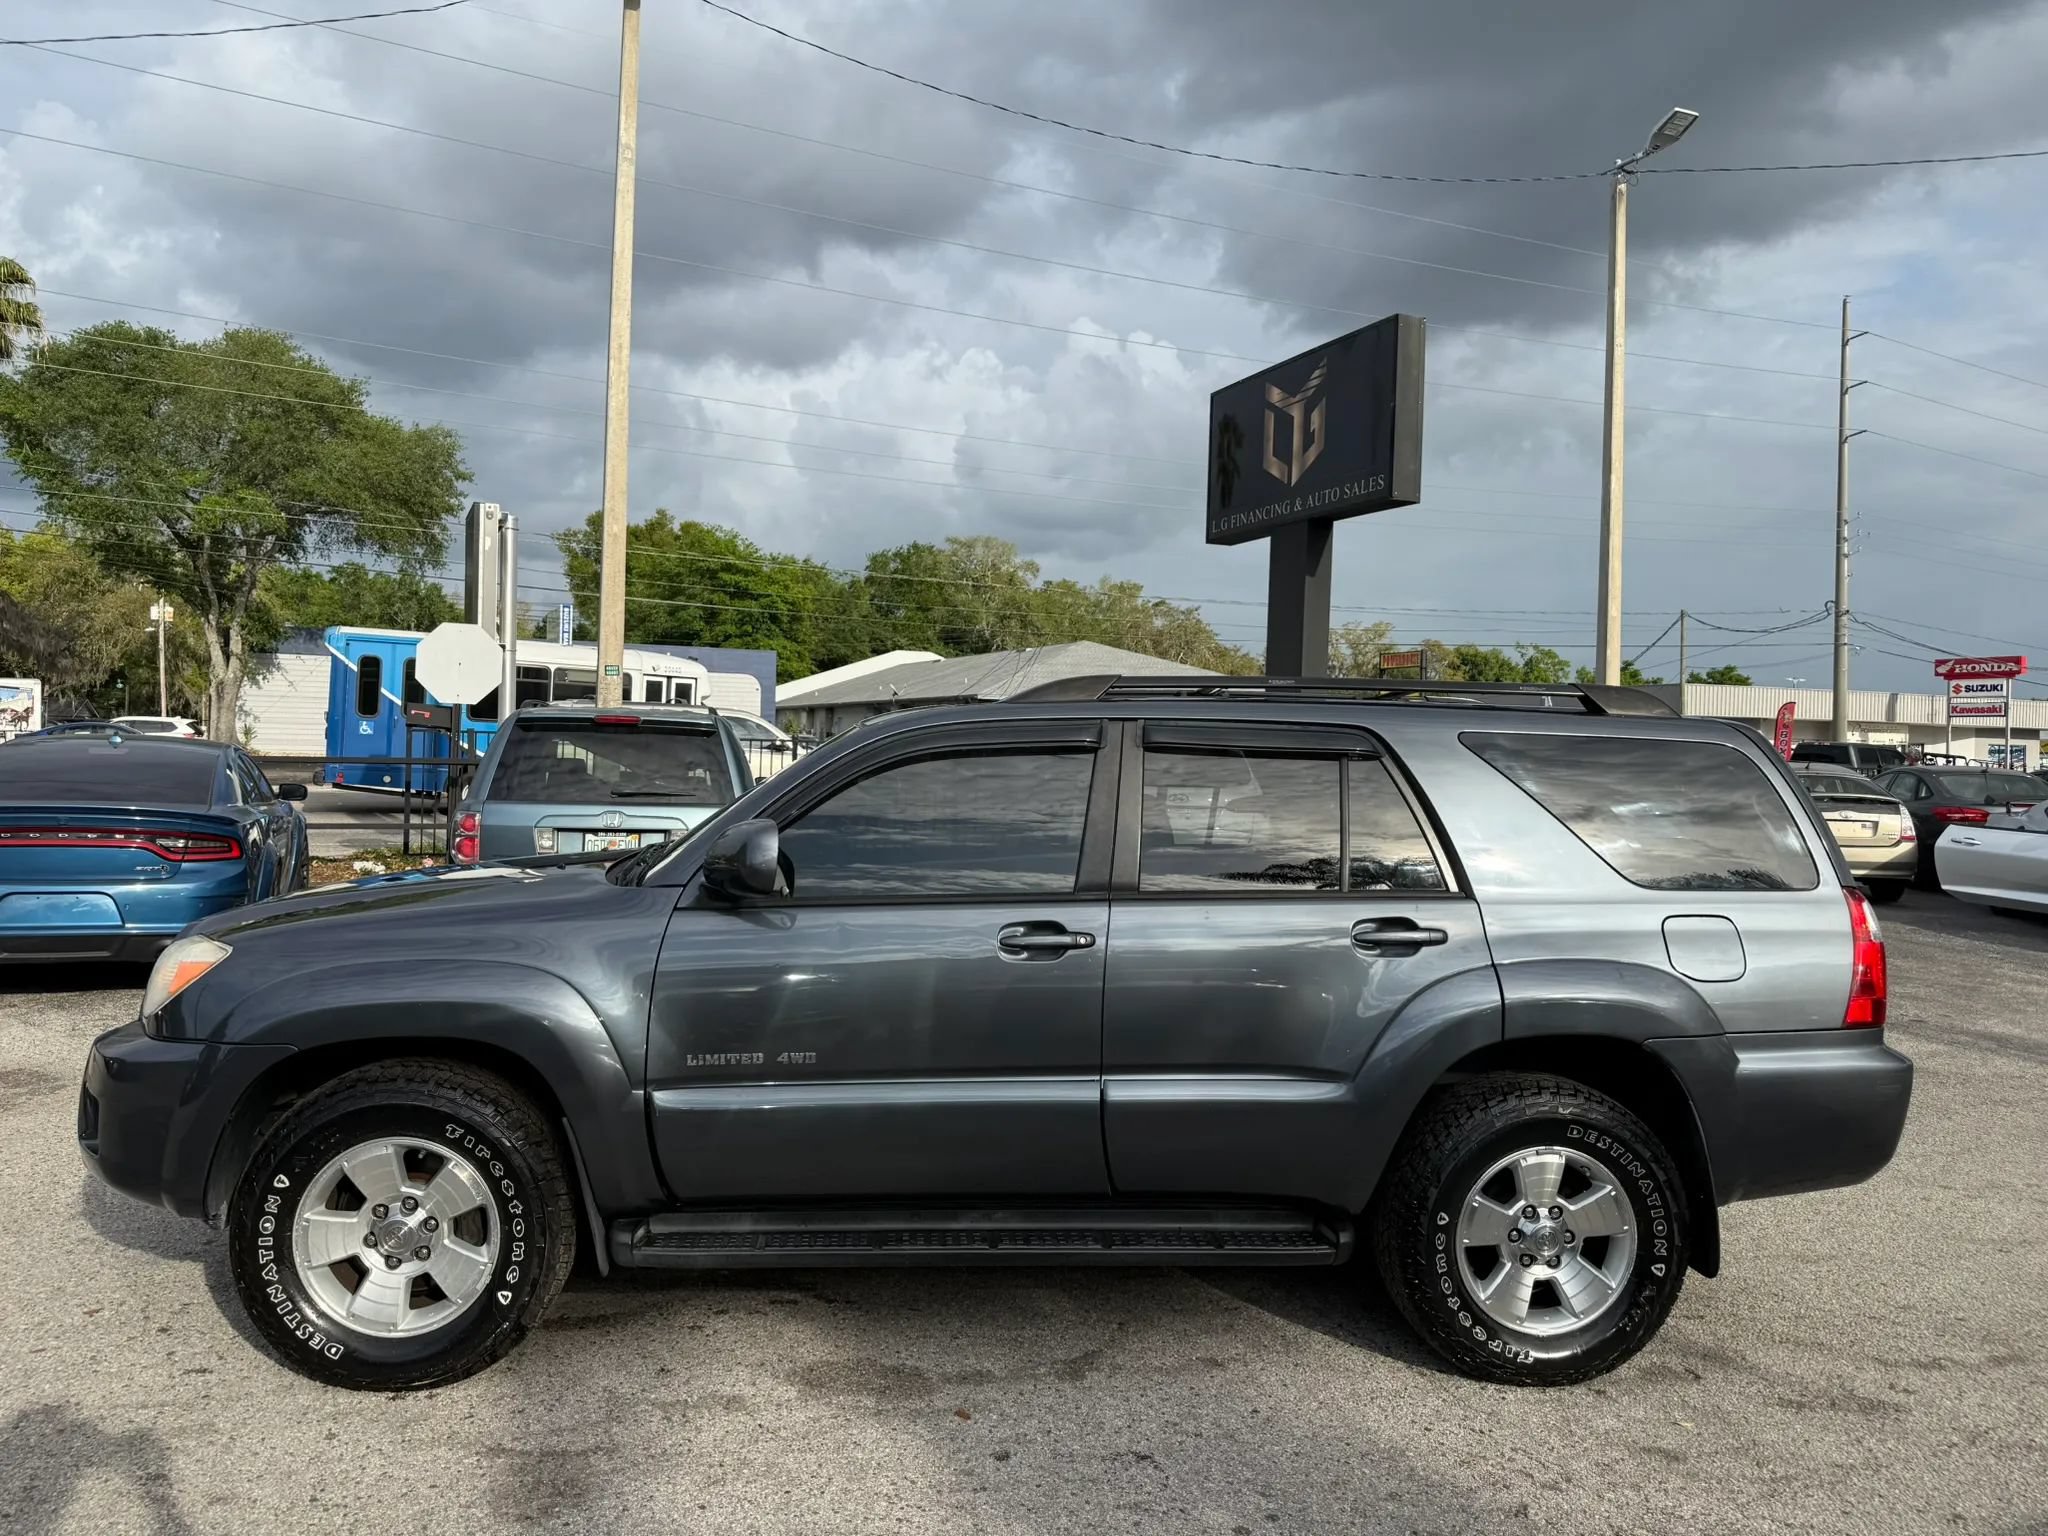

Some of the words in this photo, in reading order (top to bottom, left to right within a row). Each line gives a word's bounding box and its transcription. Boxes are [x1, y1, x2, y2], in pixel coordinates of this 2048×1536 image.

[1230, 500, 1291, 529] FINANCING
[1293, 497, 1303, 512] &
[1305, 487, 1340, 509] AUTO
[1343, 474, 1385, 499] SALES
[1954, 662, 2020, 673] HONDA
[1964, 683, 2004, 693] SUZUKI
[1951, 704, 2003, 714] Kawasaki
[686, 1052, 765, 1066] LIMITED
[776, 1051, 818, 1064] 4WD
[445, 1123, 526, 1284] Firestone
[1566, 1124, 1668, 1258] DESTINATION
[258, 1194, 345, 1360] DESTINATION
